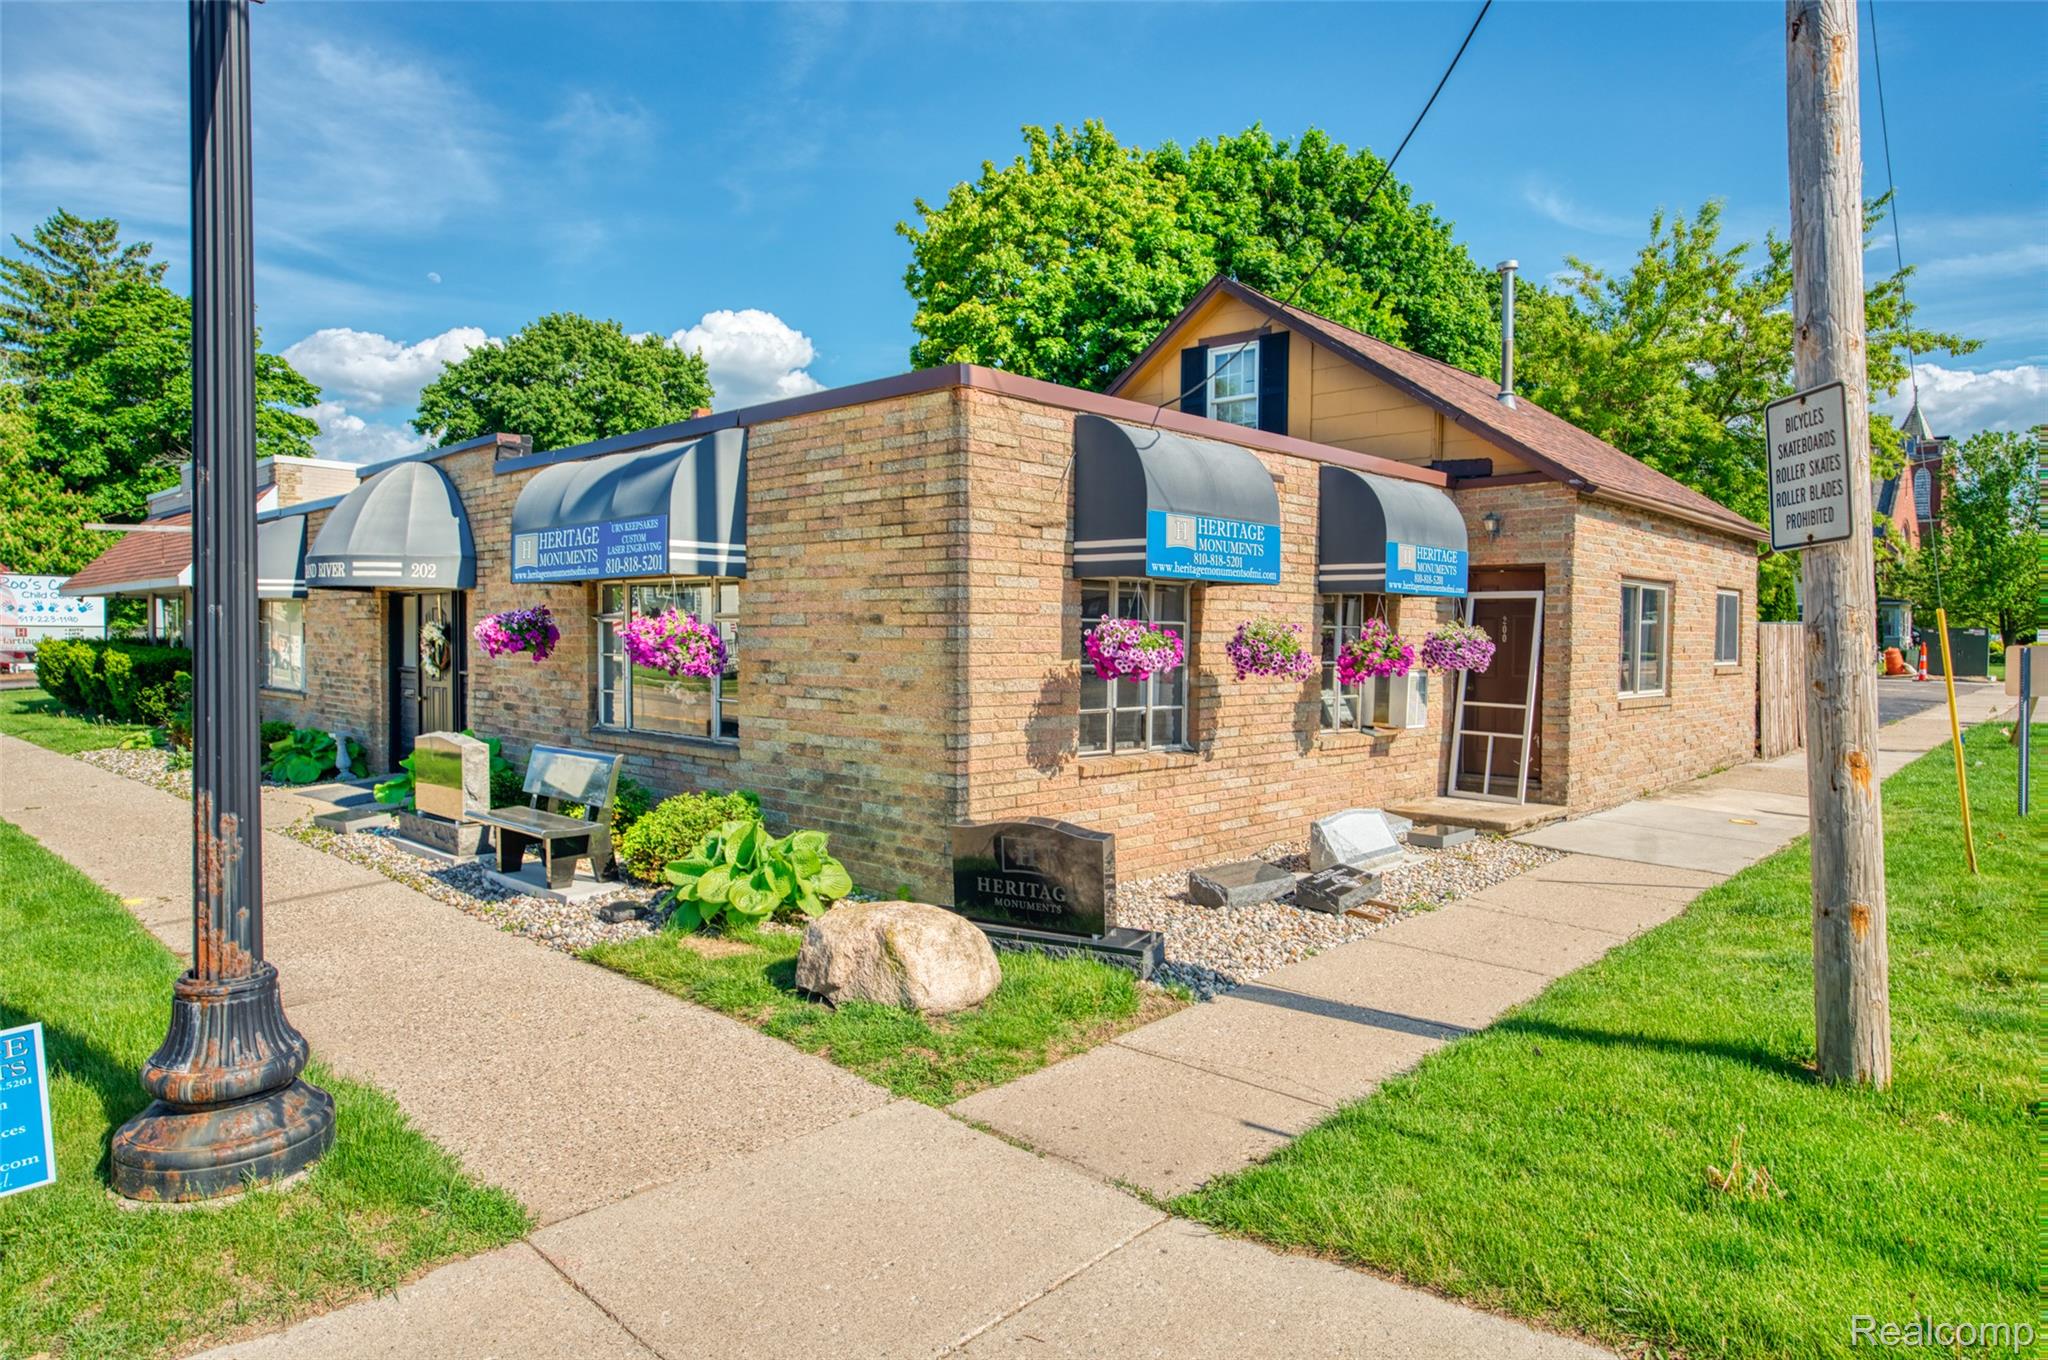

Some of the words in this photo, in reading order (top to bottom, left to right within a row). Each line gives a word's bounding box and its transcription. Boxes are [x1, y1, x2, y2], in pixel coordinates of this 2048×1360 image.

[1785, 408, 1824, 433] BICYCLES
[1778, 430, 1836, 460] SKATEBOARDS
[1776, 462, 1806, 484] ROLLER
[1809, 454, 1841, 477] SKATES
[1776, 488, 1806, 509] ROLLER
[1809, 479, 1844, 501] BLADES
[1786, 506, 1834, 531] PROHIBITED
[538, 526, 600, 550] HERITAGE
[621, 533, 647, 545] CUSTOM
[1198, 518, 1265, 541] HERITAGE
[607, 545, 625, 555] LASER
[626, 542, 662, 554] ENGRAVING
[1198, 538, 1264, 557] MONUMENTS
[1416, 546, 1458, 563] HERITAGE
[539, 548, 598, 567] MONUMENTS
[605, 554, 663, 574] 810-818-5201
[1193, 553, 1243, 568] 810-818-5201
[318, 562, 345, 578] RIVER
[410, 563, 436, 579] 202
[1152, 561, 1277, 580] www.heritagemonumentsofmi.com
[1417, 563, 1456, 576] MONUMENTS
[22, 591, 47, 599] Child
[993, 897, 1064, 914] MONUMENTS
